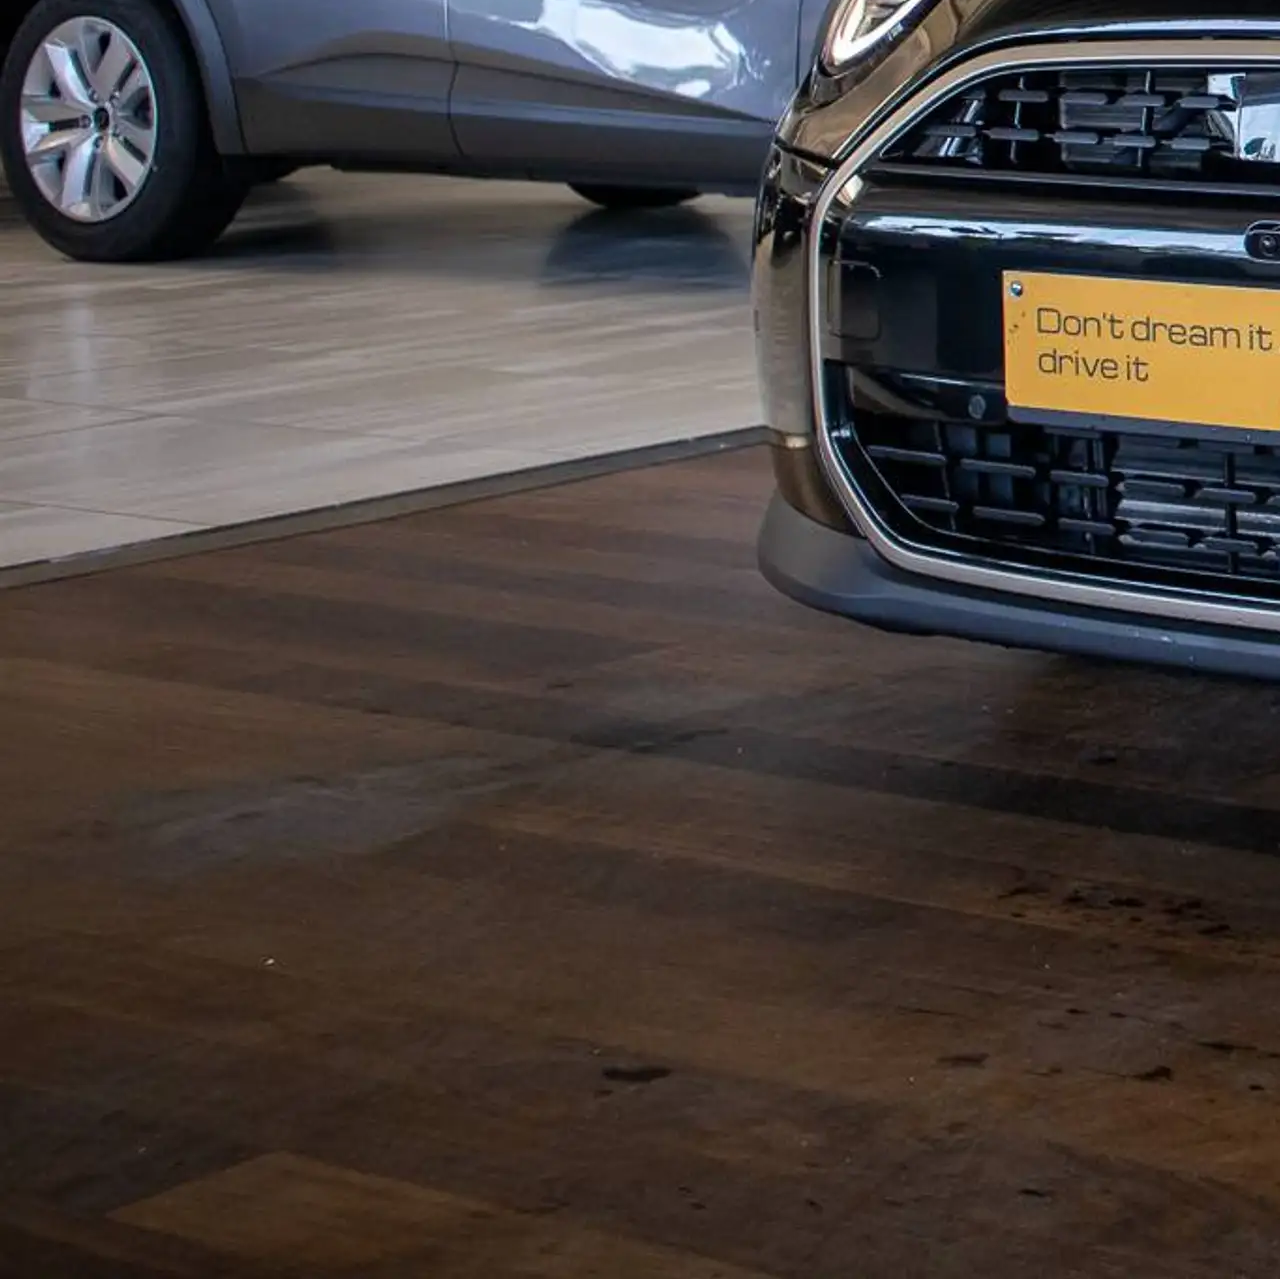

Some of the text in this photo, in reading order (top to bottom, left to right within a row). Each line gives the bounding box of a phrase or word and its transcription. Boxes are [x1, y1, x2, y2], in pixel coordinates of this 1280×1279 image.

[1036, 307, 1124, 340] Don't
[1130, 316, 1241, 349] dream
[1248, 324, 1273, 352] it
[1038, 348, 1149, 382] drive it
